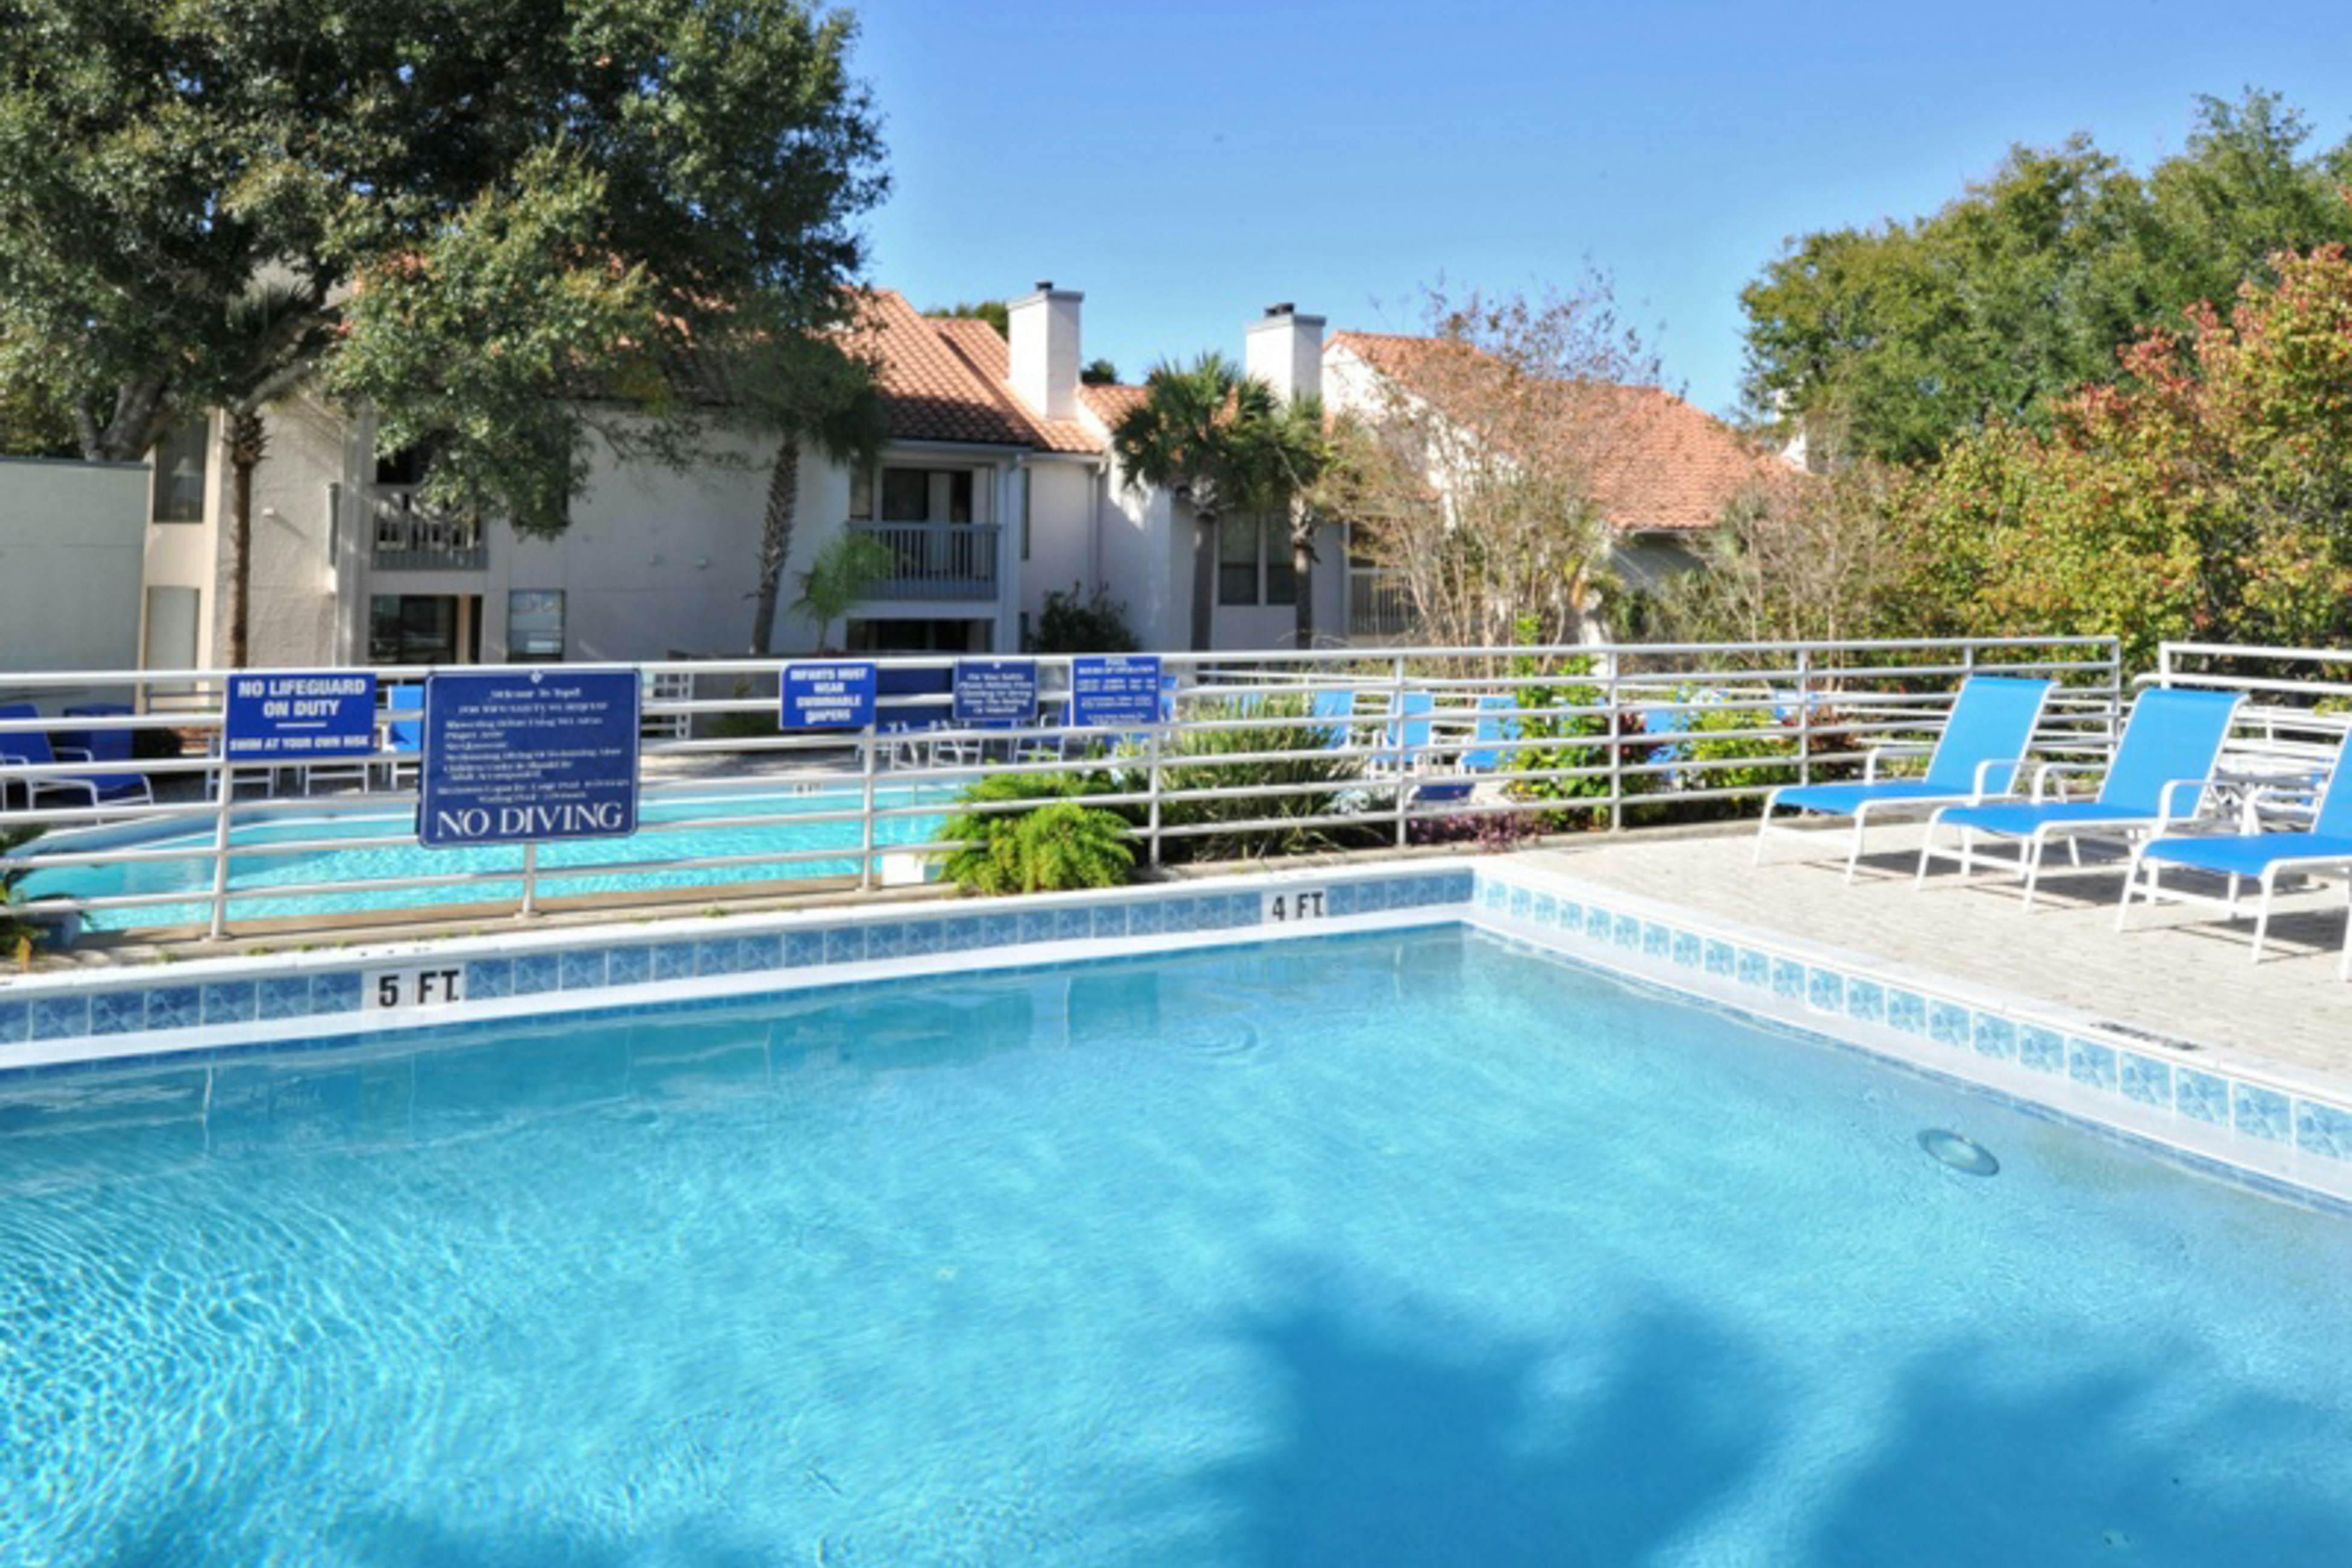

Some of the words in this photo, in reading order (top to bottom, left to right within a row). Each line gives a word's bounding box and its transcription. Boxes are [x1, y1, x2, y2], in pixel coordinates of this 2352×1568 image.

[238, 681, 265, 697] NO
[270, 678, 367, 697] LIFEGUARD
[264, 701, 289, 717] ON
[294, 700, 340, 716] DUTY
[264, 738, 280, 750] AT
[282, 737, 312, 750] YOUR
[315, 736, 341, 748] OWN
[343, 735, 368, 748] RISK
[437, 808, 490, 838] NO
[499, 803, 624, 835] DIVING
[1272, 896, 1285, 921] 4
[379, 974, 400, 1007] 5
[418, 969, 460, 1004] FT.
